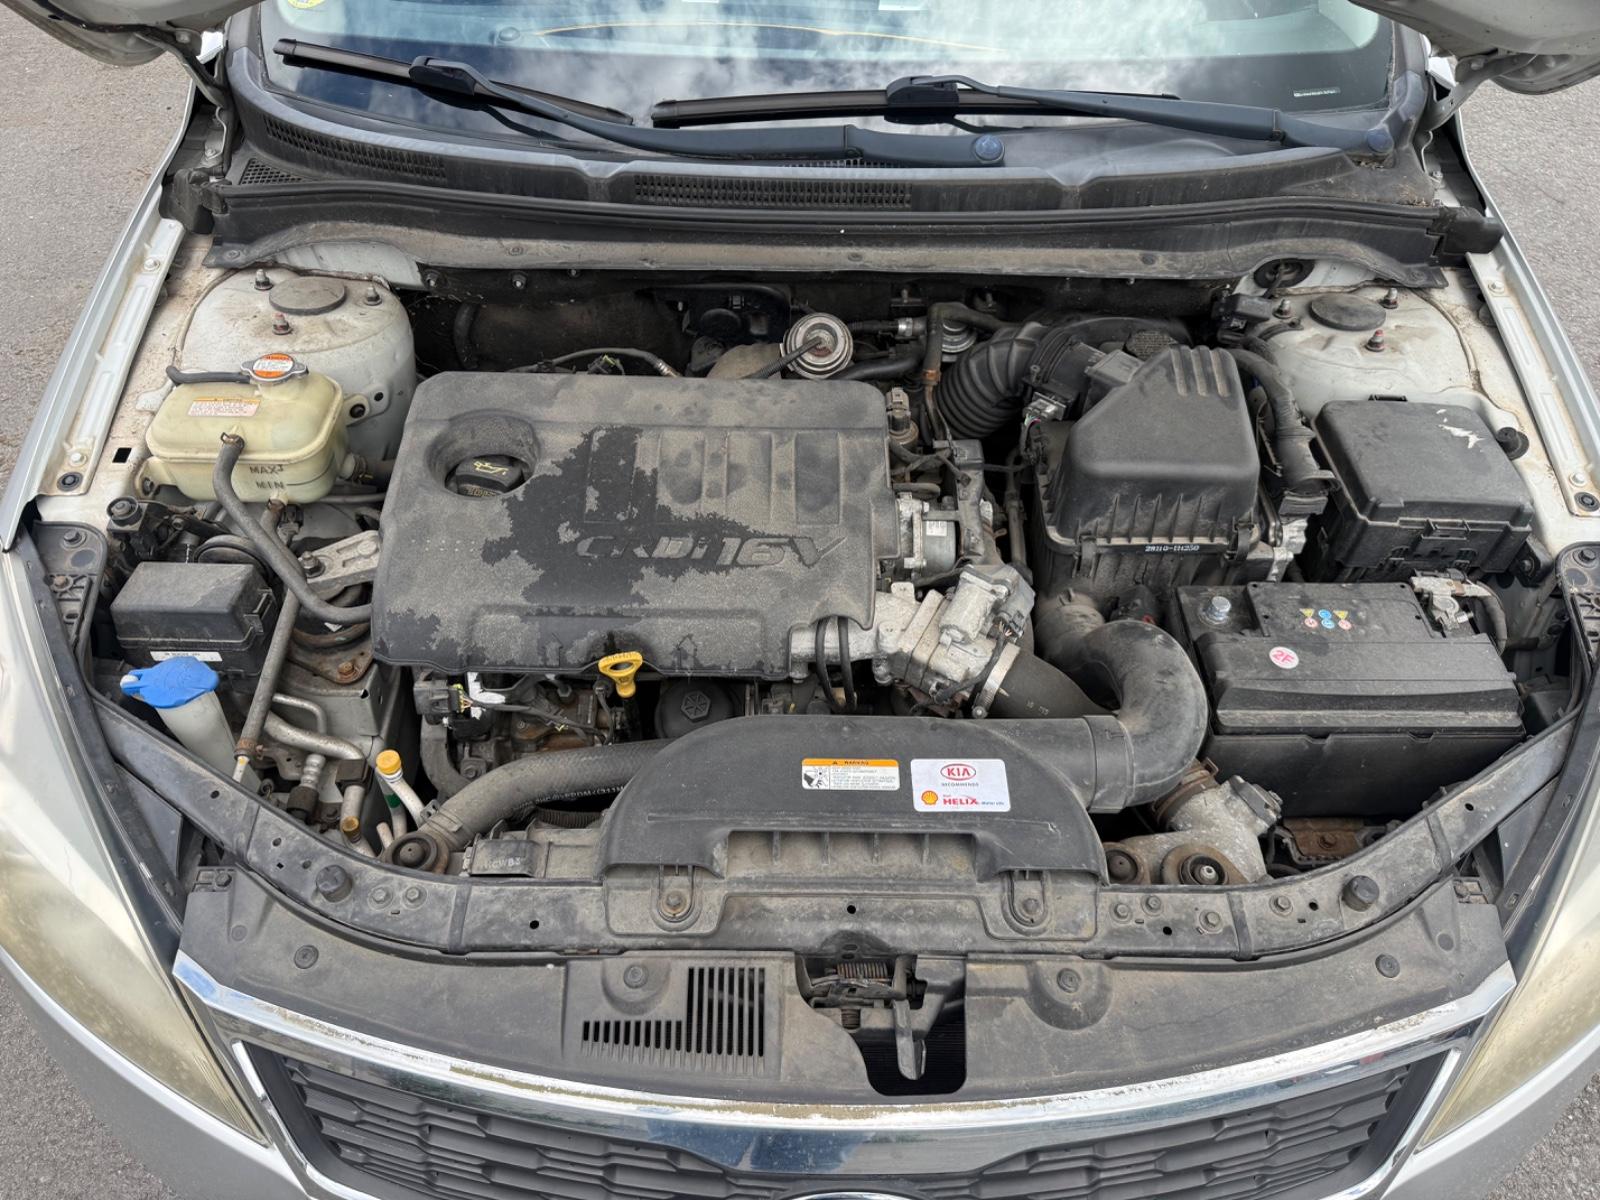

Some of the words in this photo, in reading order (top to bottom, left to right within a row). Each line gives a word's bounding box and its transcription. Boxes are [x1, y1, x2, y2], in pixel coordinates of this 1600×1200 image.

[256, 481, 284, 489] MIN
[1272, 650, 1295, 663] 2F
[947, 768, 971, 776] KIA
[943, 798, 978, 806] HELIX
